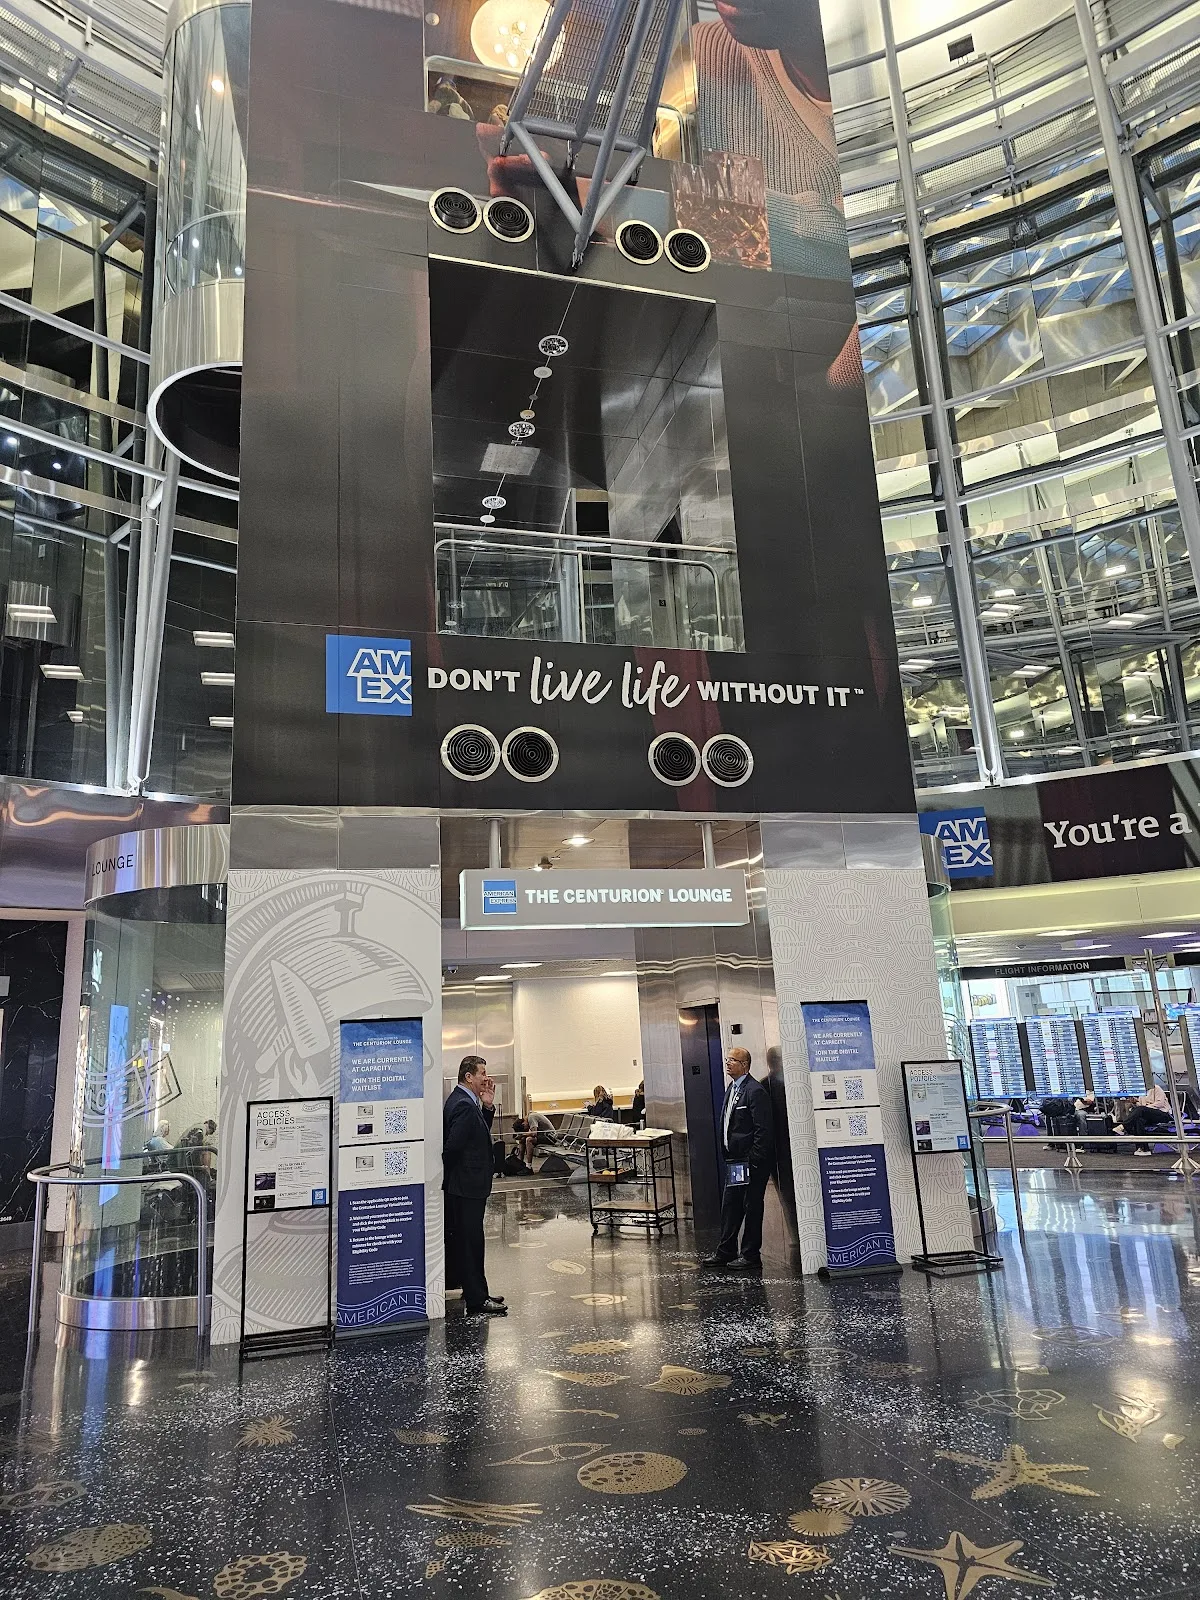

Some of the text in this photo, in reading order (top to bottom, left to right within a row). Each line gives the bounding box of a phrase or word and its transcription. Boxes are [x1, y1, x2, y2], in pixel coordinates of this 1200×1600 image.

[347, 648, 411, 676] AM
[356, 675, 412, 704] EX
[428, 667, 520, 692] DON'T
[530, 656, 612, 705] live
[621, 661, 691, 715] life
[697, 681, 818, 705] WITHOUT
[935, 817, 989, 841] AM
[1044, 813, 1193, 849] You're a
[91, 854, 134, 877] LOUNGE
[943, 839, 994, 869] EX
[525, 889, 560, 904] THE
[669, 888, 732, 902] LOUNGE
[995, 962, 1090, 976] FLIGHT INFORMATION
[256, 1110, 290, 1118] ACCESS
[256, 1117, 294, 1126] POLICIES
[828, 1240, 880, 1263] AMERICAN
[337, 1294, 408, 1324] AMERICAN
